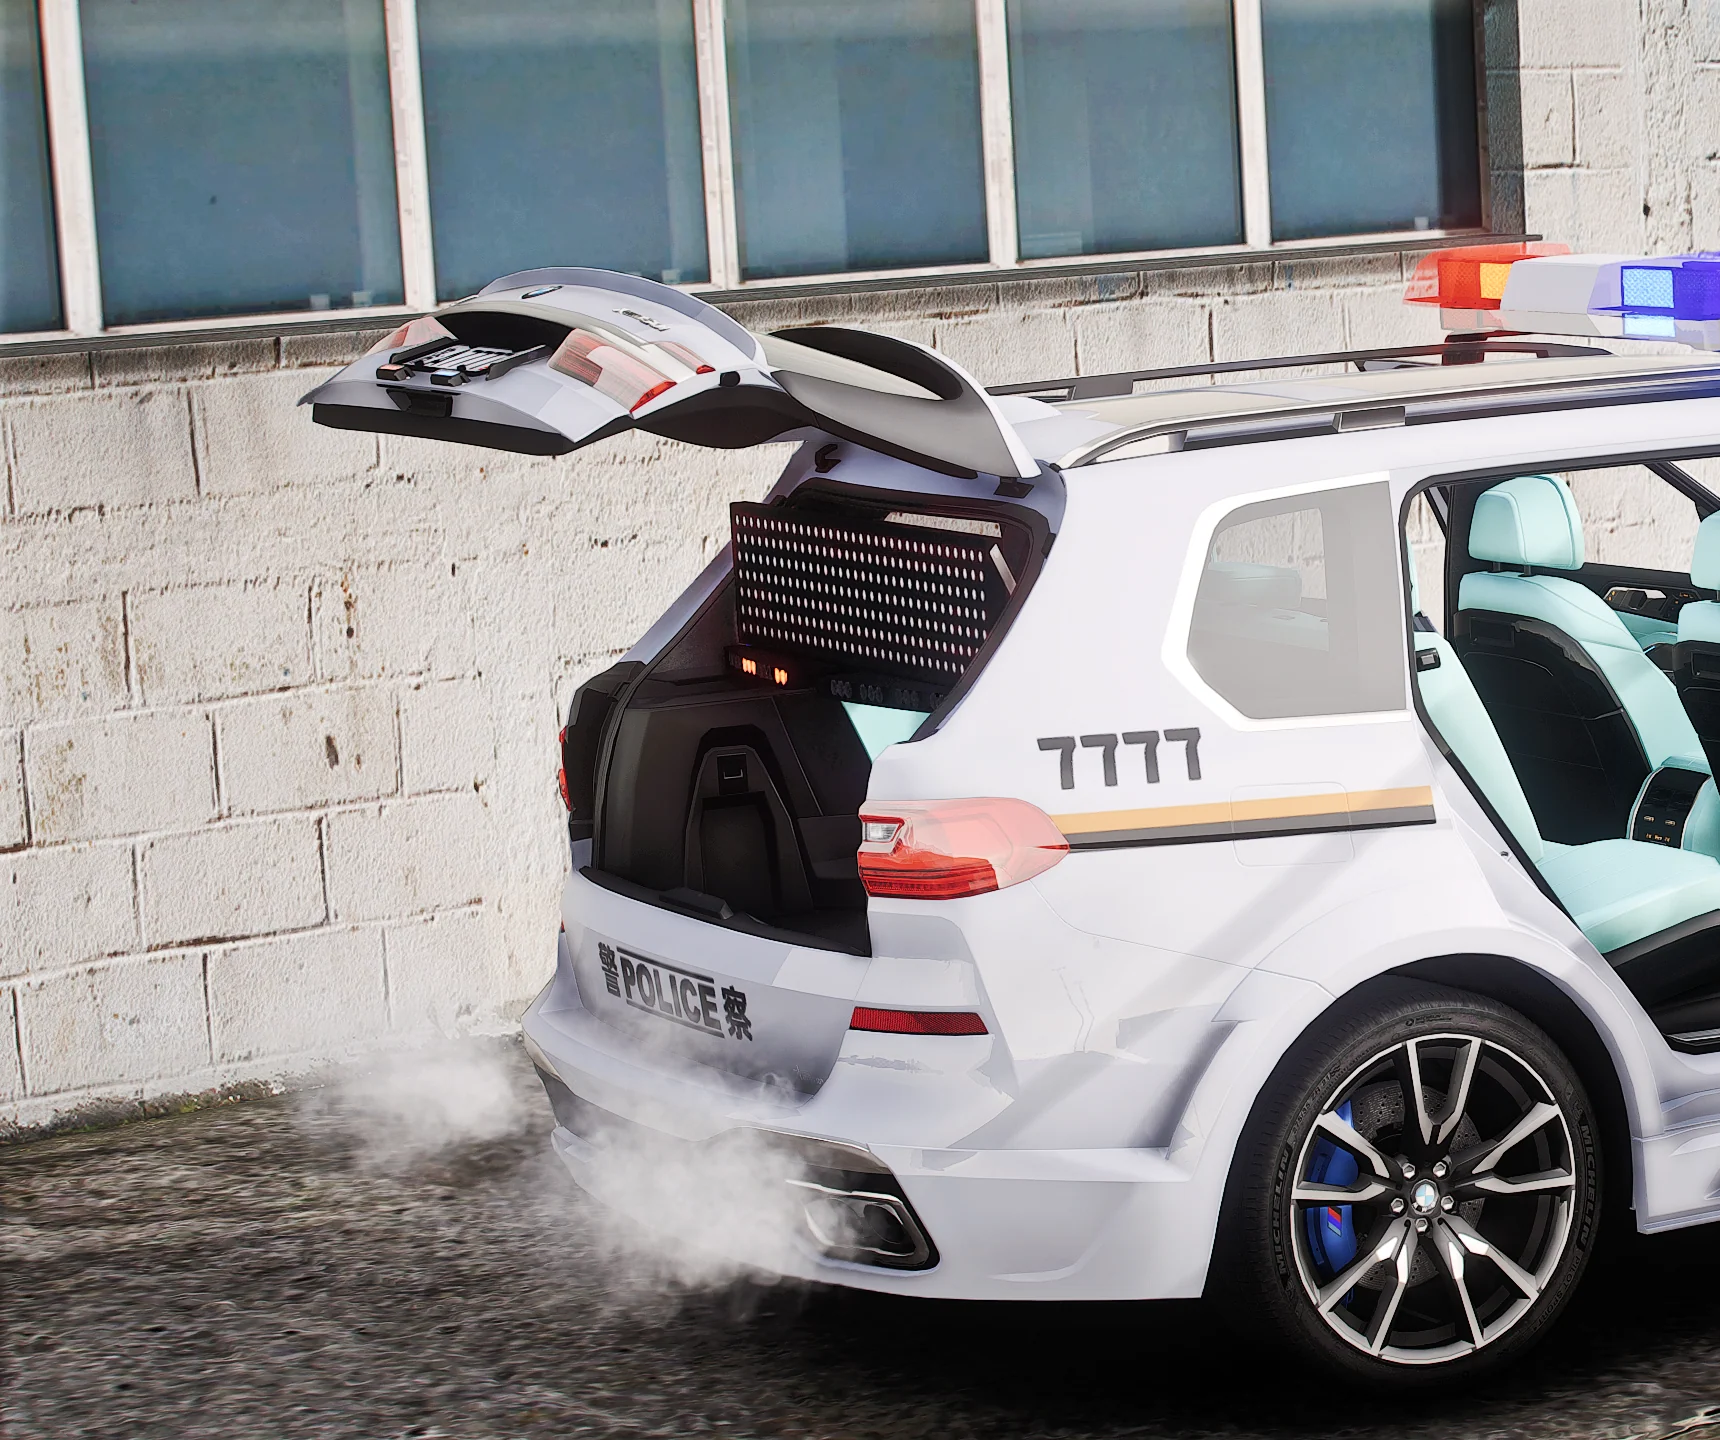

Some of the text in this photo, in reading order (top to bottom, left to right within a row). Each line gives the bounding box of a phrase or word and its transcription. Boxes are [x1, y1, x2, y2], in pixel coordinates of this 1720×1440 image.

[1037, 727, 1201, 790] 7777
[598, 941, 753, 1042] 警 POLICE 察
[1273, 1147, 1290, 1276] MICHELIN
[1580, 1124, 1597, 1249] MICHELIN
[1563, 1255, 1581, 1290] PILOT
